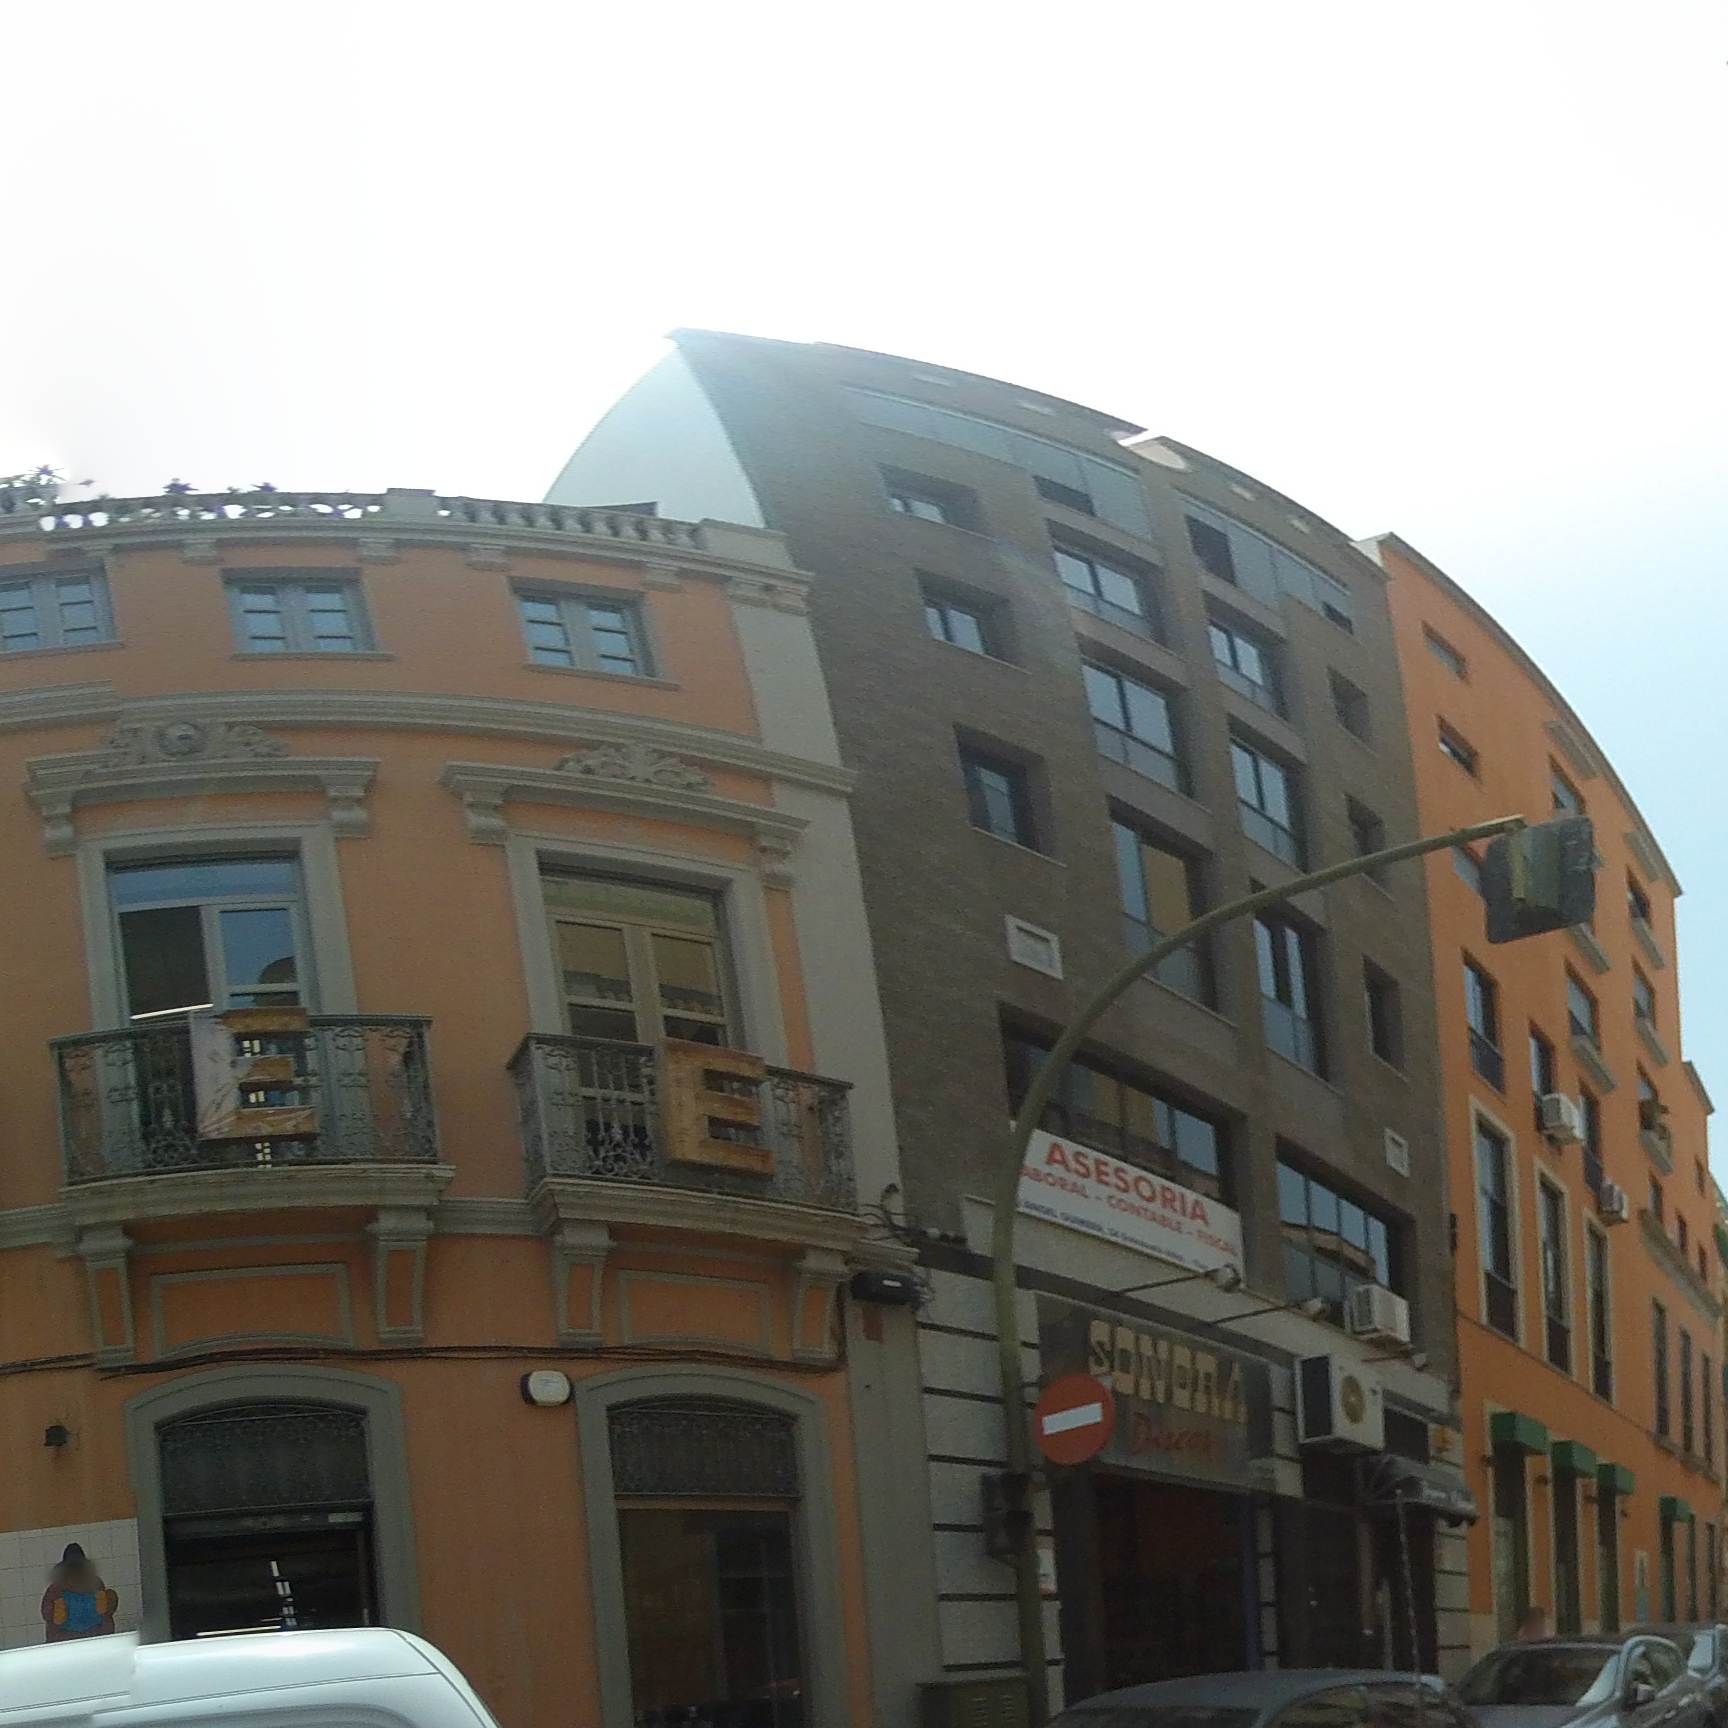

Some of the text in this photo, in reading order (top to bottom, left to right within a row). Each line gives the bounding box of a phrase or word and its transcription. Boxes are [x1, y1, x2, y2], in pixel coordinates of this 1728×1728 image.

[1021, 1163, 1089, 1198] ABORAL
[1045, 1143, 1209, 1227] ASESORIA
[1087, 1319, 1249, 1424] SONORA
